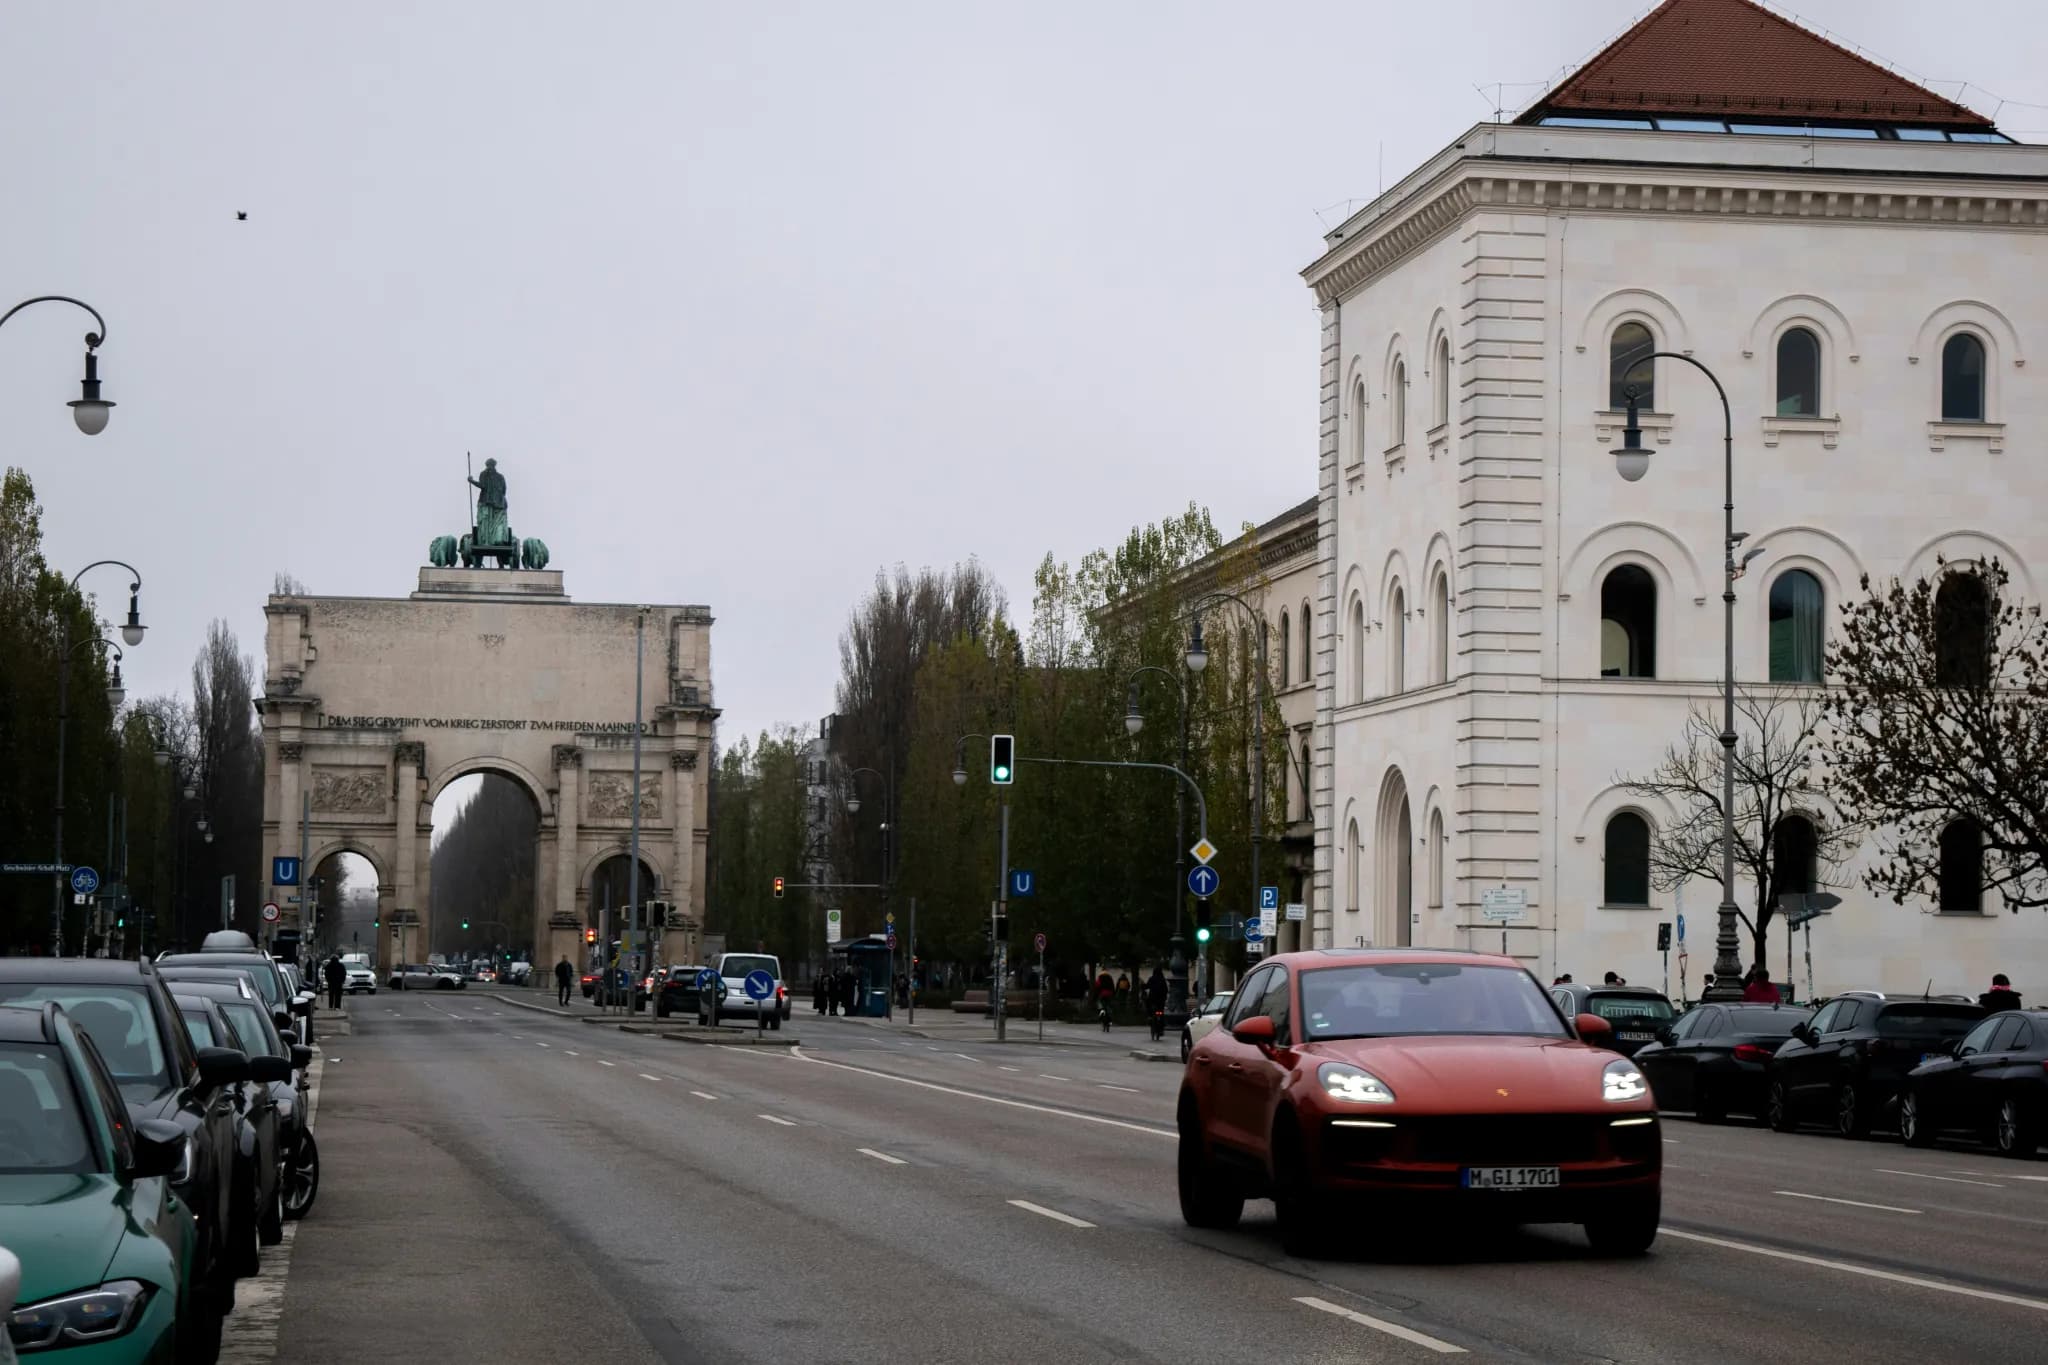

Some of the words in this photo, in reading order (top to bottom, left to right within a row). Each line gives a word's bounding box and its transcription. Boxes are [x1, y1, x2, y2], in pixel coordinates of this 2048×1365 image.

[328, 715, 351, 727] DEM
[353, 716, 374, 728] SIEG
[375, 717, 421, 730] GEWEIHT
[423, 718, 448, 729] VOM
[450, 719, 479, 729] KRIEG
[555, 721, 594, 732] FRIEDEN
[279, 862, 293, 880] U
[1016, 874, 1030, 892] U
[1263, 890, 1273, 906] P
[1471, 1169, 1482, 1186] M
[1492, 1169, 1513, 1185] GI
[1517, 1169, 1557, 1185] 1701
